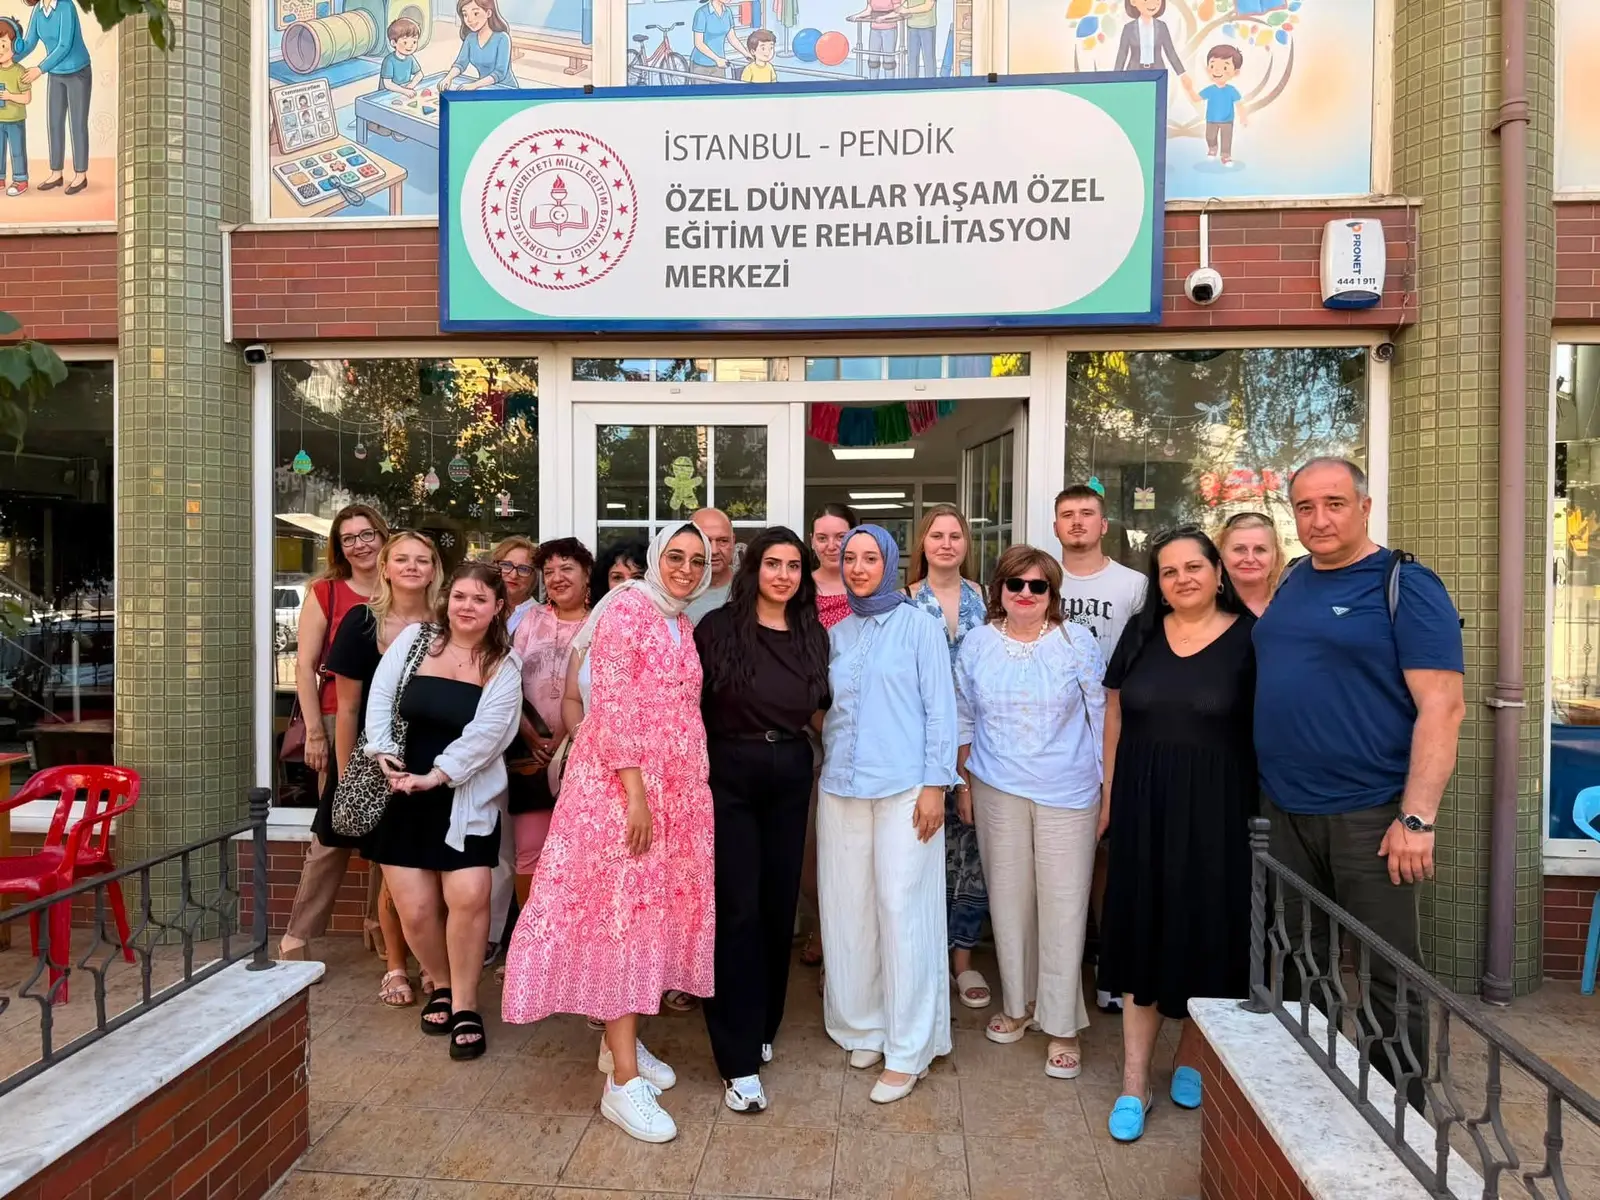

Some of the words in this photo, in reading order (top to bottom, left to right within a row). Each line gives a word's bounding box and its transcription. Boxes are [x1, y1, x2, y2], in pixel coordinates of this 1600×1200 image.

[665, 129, 811, 162] İSTANBUL
[840, 122, 955, 158] PENDİK
[555, 157, 586, 172] MİLLİ
[510, 157, 552, 220] CUMHURİYETİ
[585, 170, 609, 206] EĞİTİM
[665, 183, 739, 213] ÖZEL
[748, 181, 907, 212] DÜNYALAR
[913, 181, 1018, 213] YAŞAM
[1026, 173, 1105, 204] ÖZEL
[513, 224, 550, 259] TÜRKİYE
[569, 209, 609, 259] BAKANLIĞI
[665, 219, 764, 250] EĞİTİM
[770, 224, 807, 249] VE
[816, 214, 1071, 248] REHABİLİTASYON
[1352, 233, 1362, 275] PRONET
[665, 258, 789, 289] MERKEZİ
[1337, 277, 1355, 285] 444
[1357, 277, 1361, 285] 1
[1362, 277, 1376, 285] 911
